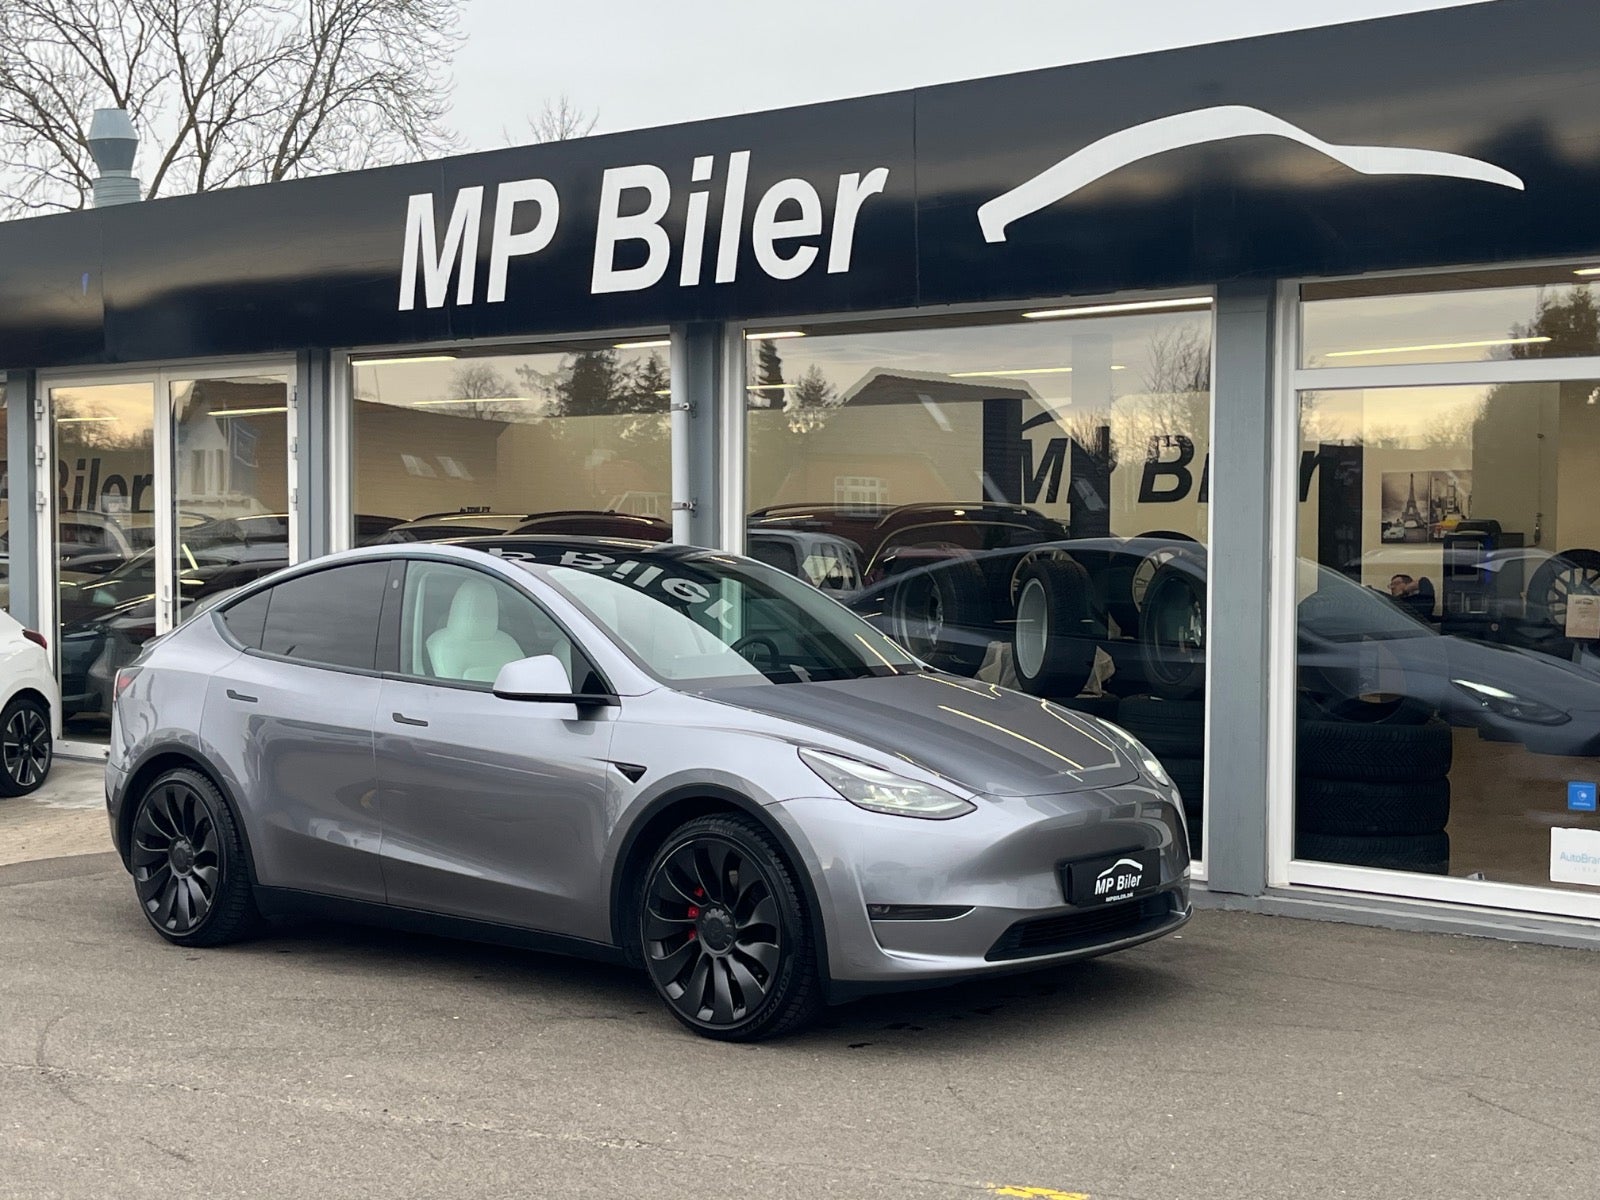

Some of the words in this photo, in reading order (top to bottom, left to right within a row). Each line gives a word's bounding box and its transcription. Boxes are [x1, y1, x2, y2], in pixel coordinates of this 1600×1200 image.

[398, 177, 560, 311] MP
[590, 149, 889, 294] Biler
[1094, 877, 1115, 896] MP
[1116, 873, 1143, 891] Biler
